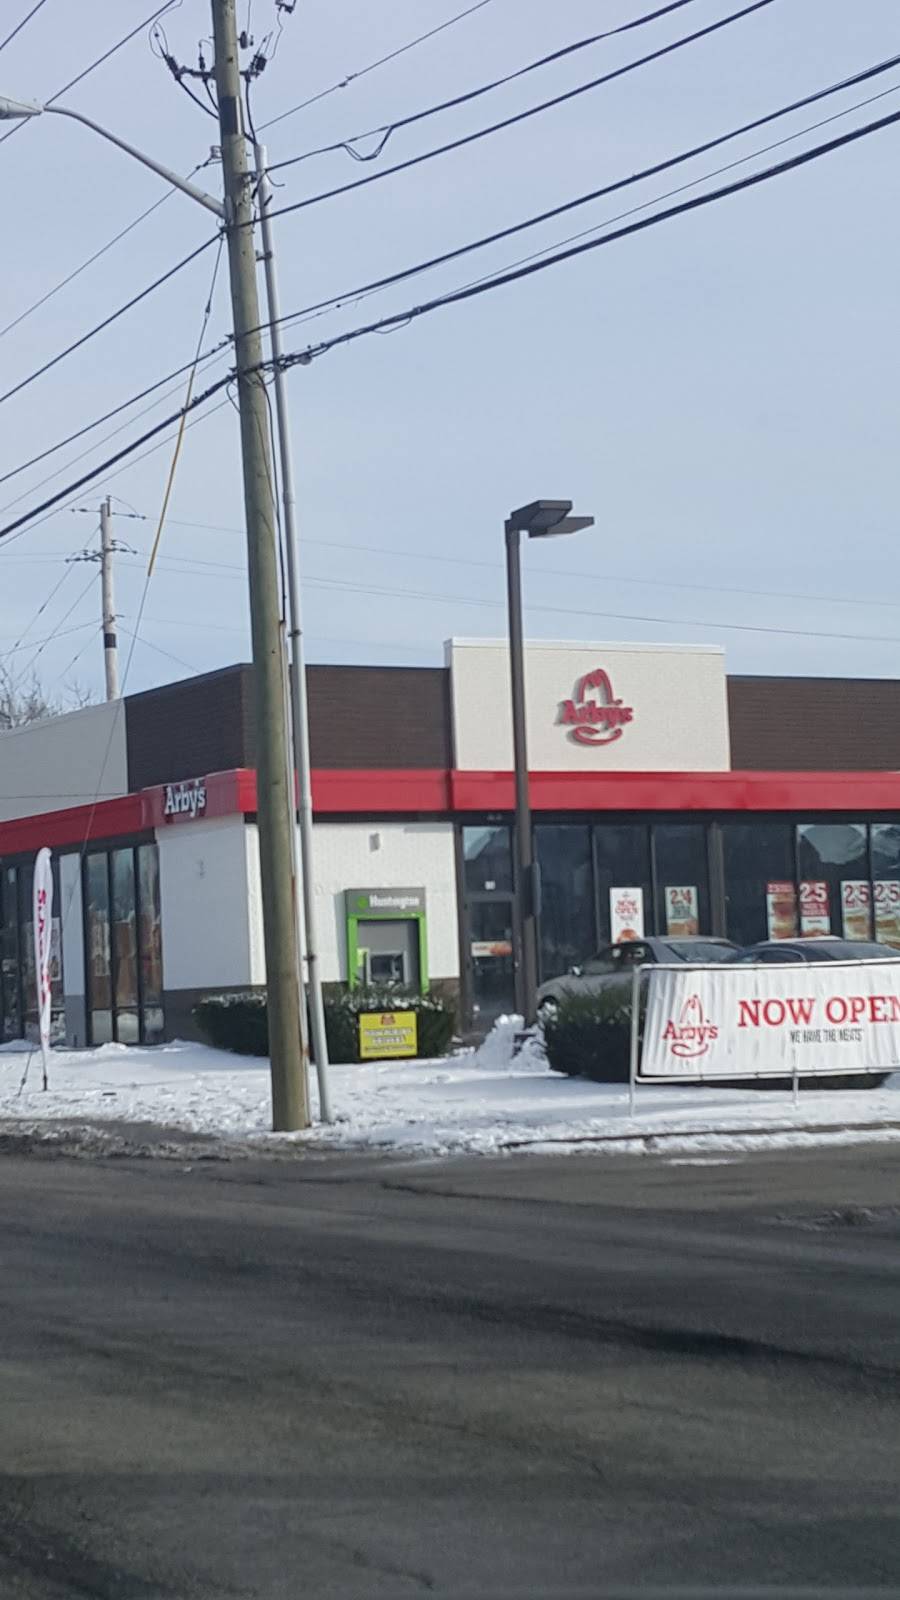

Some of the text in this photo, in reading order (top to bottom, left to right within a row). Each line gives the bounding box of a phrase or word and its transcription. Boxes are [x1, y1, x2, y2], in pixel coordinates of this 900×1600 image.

[164, 780, 207, 818] Arby's
[737, 999, 815, 1027] NOW
[661, 1019, 719, 1046] Arby's
[790, 1029, 801, 1043] WE
[803, 1029, 822, 1043] HAVE
[824, 1028, 837, 1042] THE
